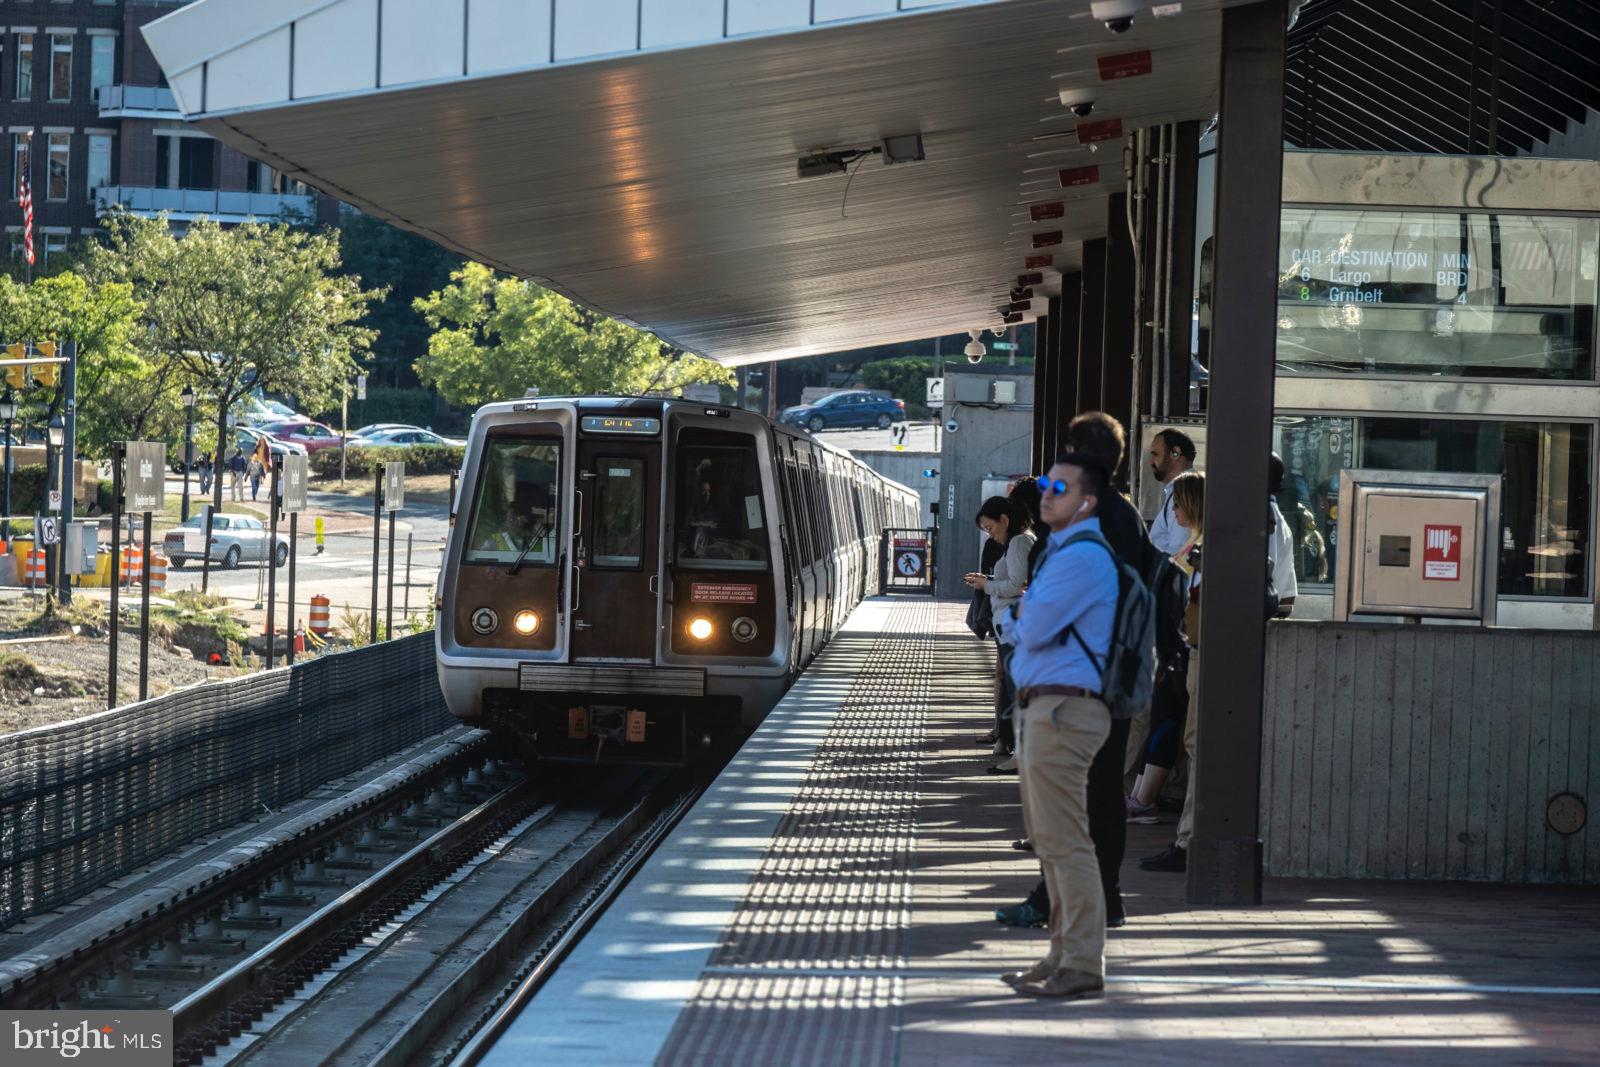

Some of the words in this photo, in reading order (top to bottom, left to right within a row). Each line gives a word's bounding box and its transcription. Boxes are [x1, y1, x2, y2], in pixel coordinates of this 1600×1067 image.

[1291, 248, 1321, 264] CAR
[1330, 249, 1428, 267] DESTINATION
[1443, 253, 1471, 268] MIN
[1301, 267, 1311, 282] 6
[1329, 267, 1371, 287] Largo
[1436, 271, 1468, 287] BRD
[1300, 286, 1310, 301] 8
[1329, 286, 1384, 303] Grnbelt
[1457, 291, 1467, 304] 4
